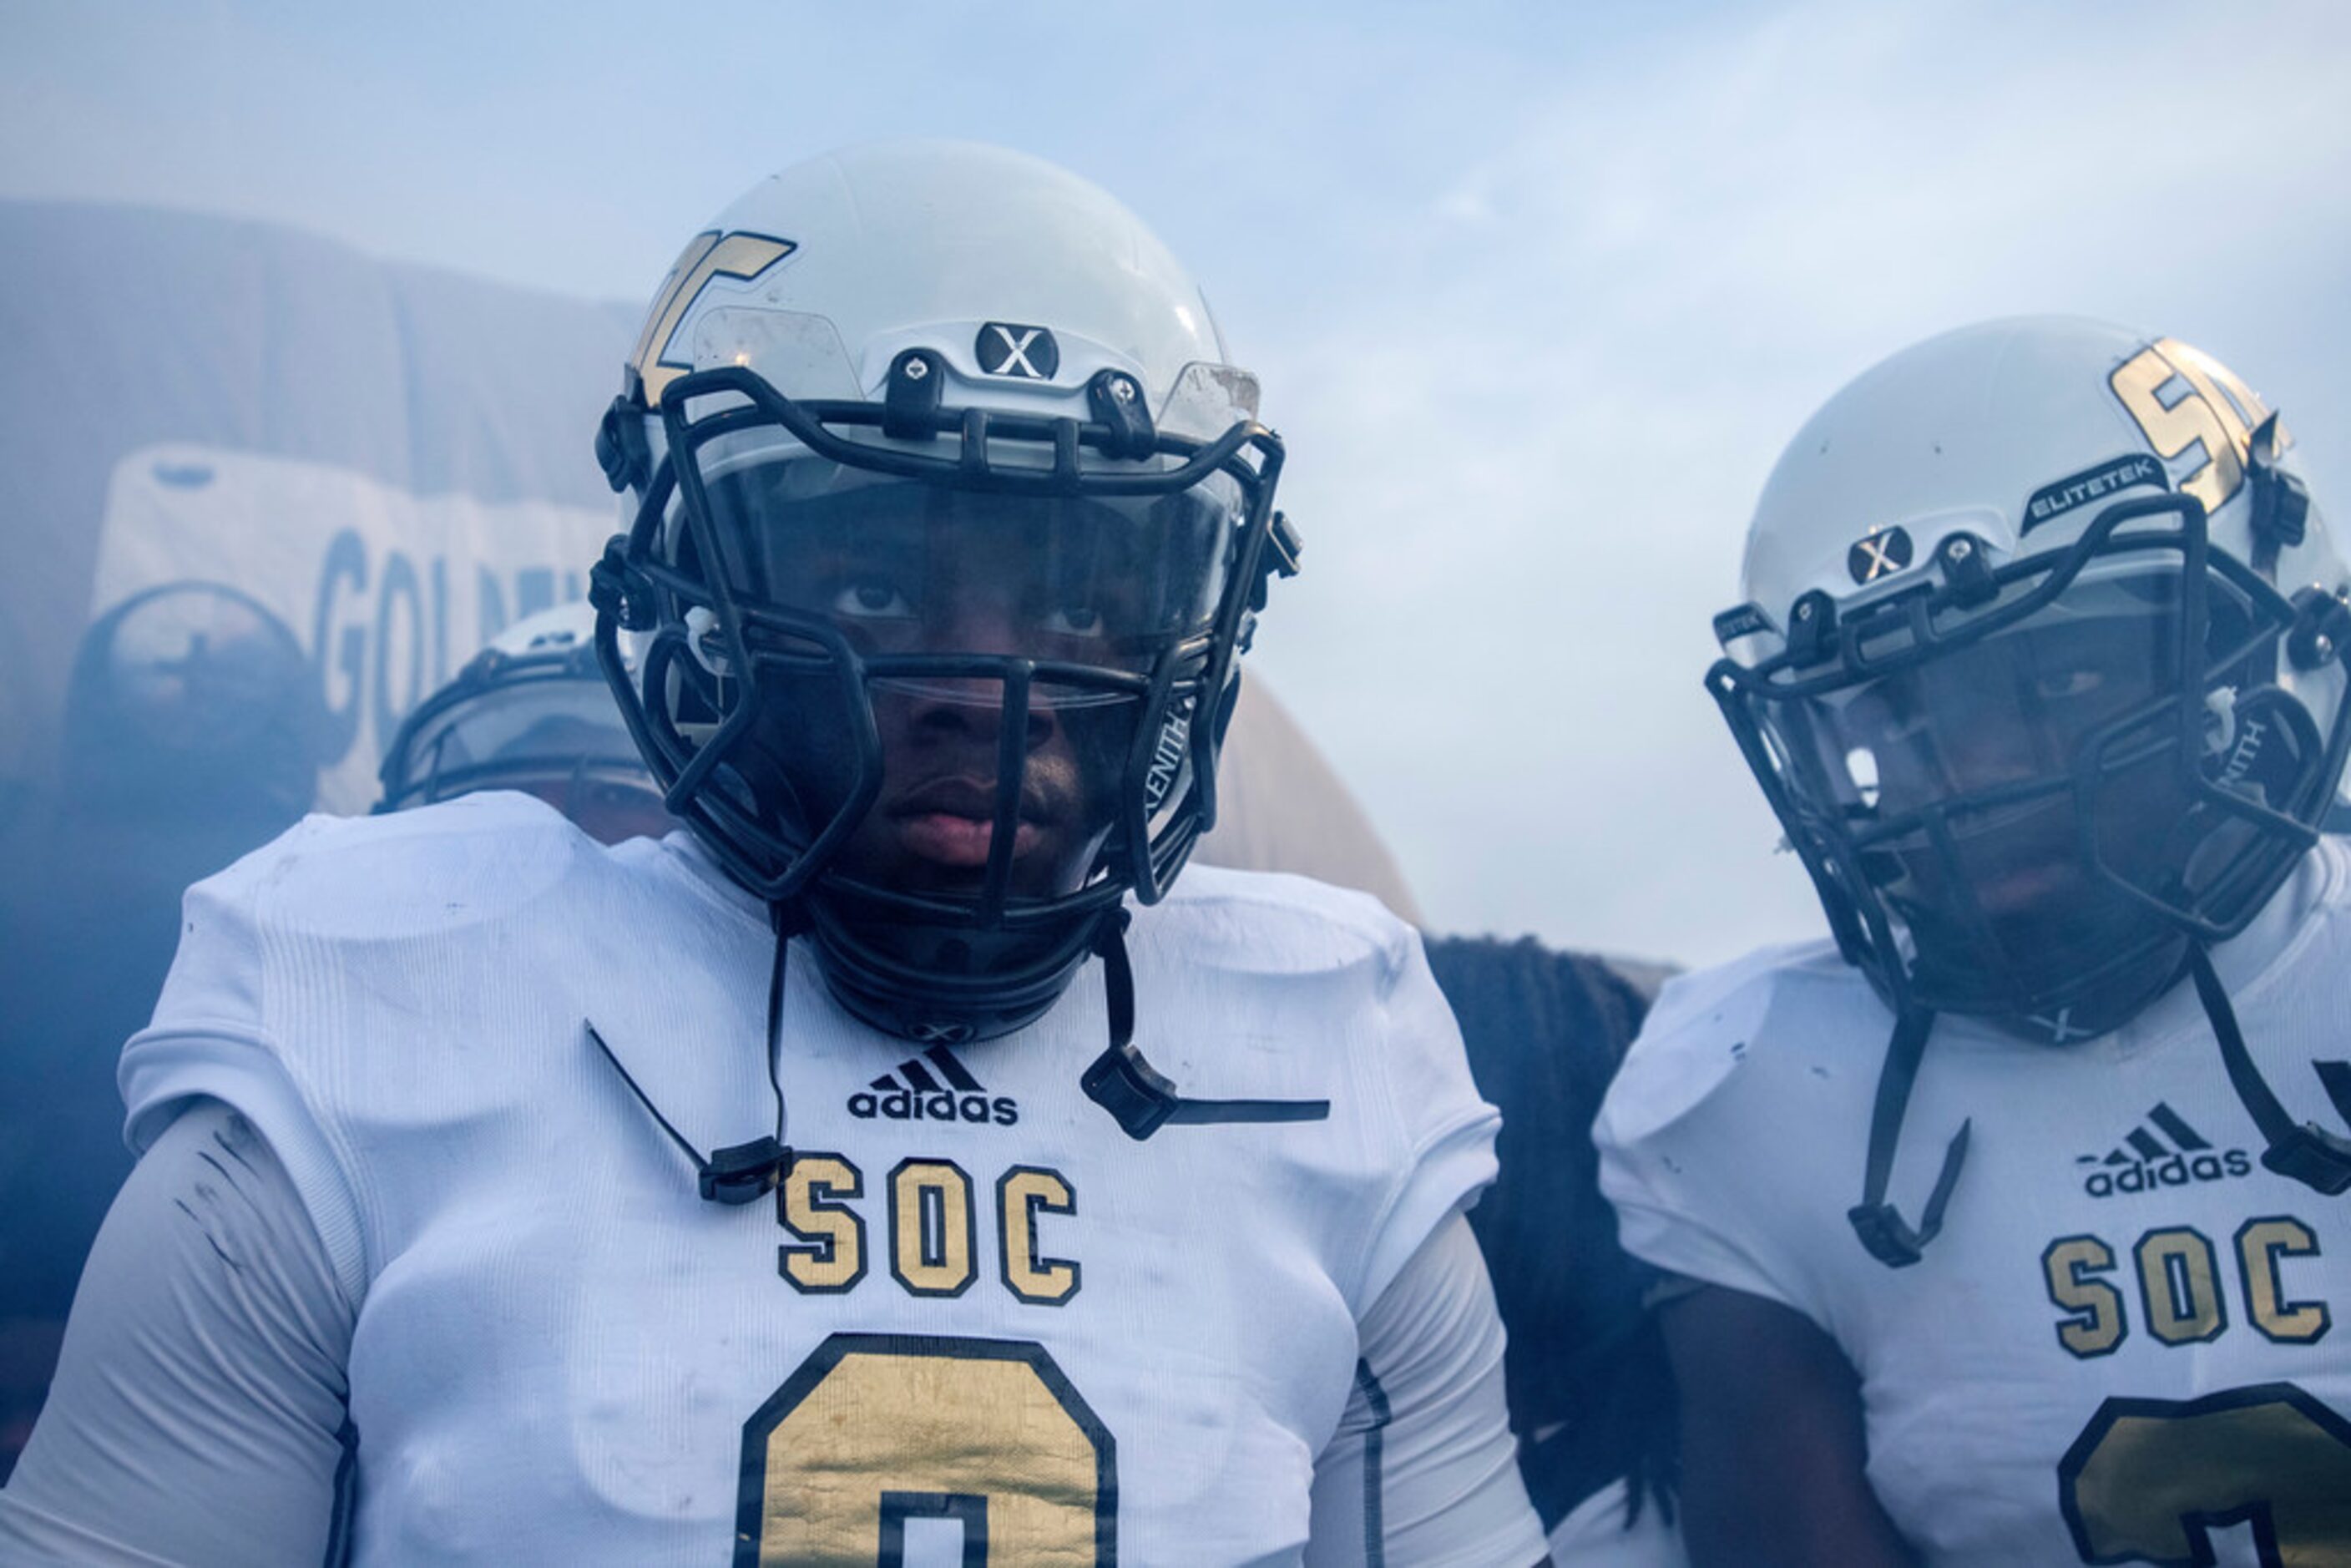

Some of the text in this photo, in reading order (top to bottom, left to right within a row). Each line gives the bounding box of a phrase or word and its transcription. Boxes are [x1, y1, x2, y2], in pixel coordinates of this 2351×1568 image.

[2030, 460, 2155, 518] ELITETEK
[2216, 719, 2267, 787] NITH
[847, 1089, 1019, 1126] adidas
[2084, 1149, 2252, 1198] adidas
[776, 1150, 1082, 1308] SOC
[2040, 1215, 2333, 1360] SOC
